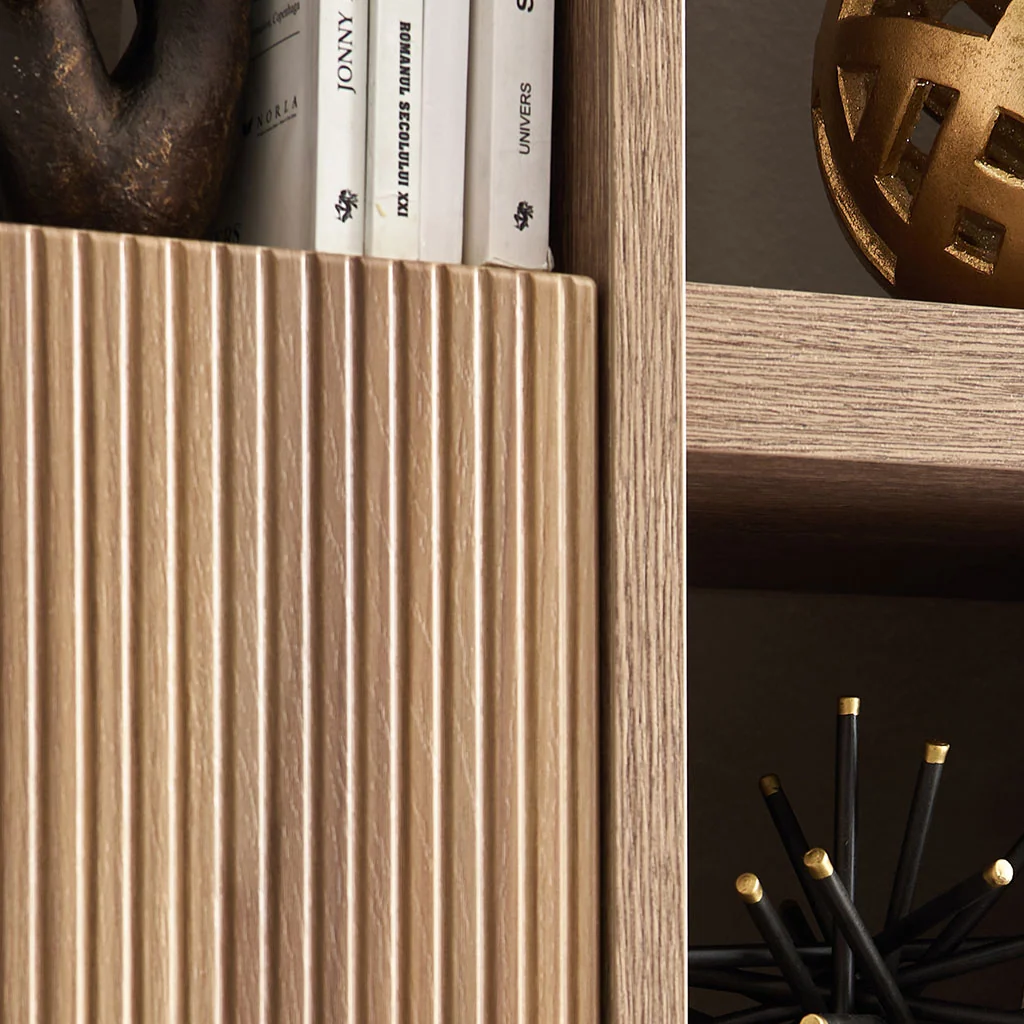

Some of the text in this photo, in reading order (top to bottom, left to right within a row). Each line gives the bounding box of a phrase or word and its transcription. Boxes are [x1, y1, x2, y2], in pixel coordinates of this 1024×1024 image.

[338, 12, 356, 94] JONNY
[397, 21, 411, 218] ROMANUL SECOLULUI XXI
[519, 82, 532, 155] UNIVERS
